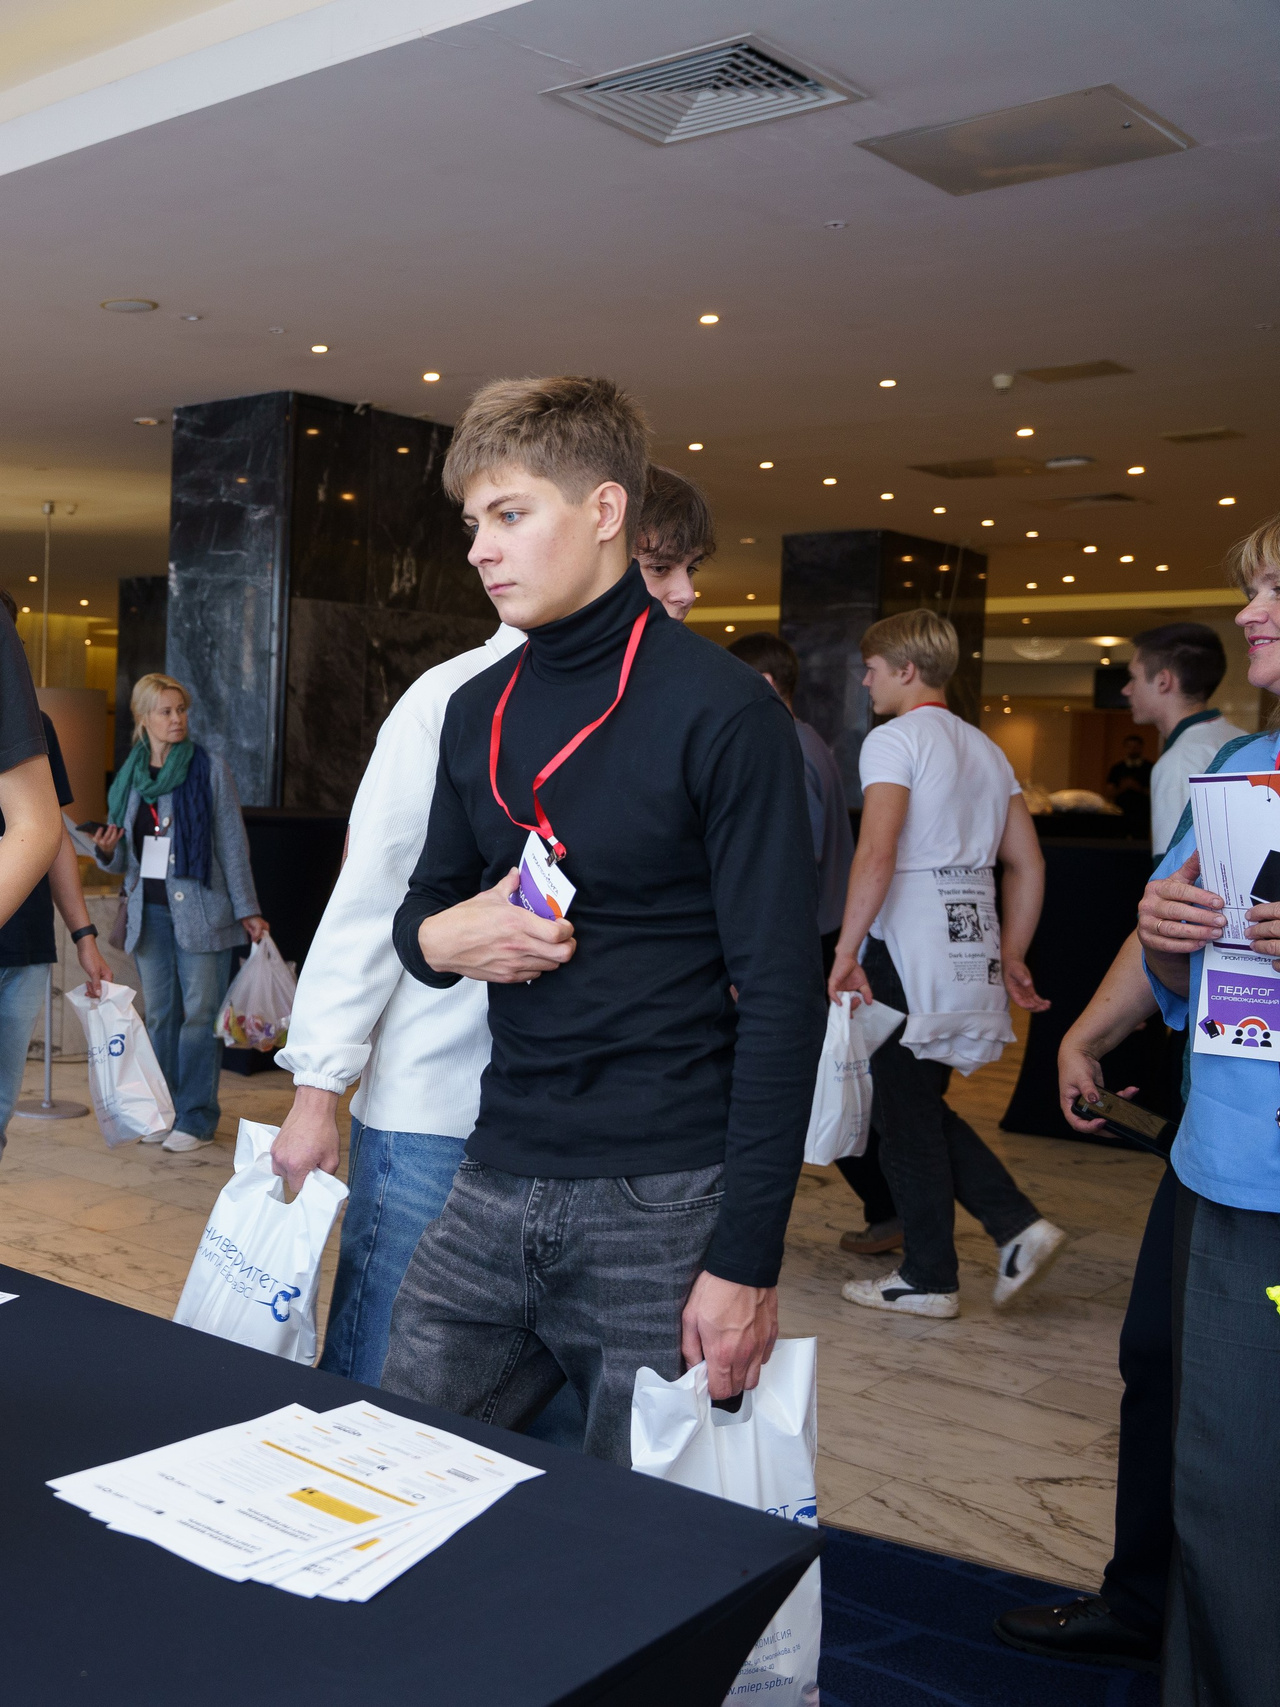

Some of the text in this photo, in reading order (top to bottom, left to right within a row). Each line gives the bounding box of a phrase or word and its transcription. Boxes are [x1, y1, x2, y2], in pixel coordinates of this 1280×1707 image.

[1221, 955, 1272, 963] ПРОМТЕХНОЛИ
[1217, 985, 1275, 996] ПЕДАГОГ
[1211, 995, 1280, 1005] СОПРОВОЖДАЮЩИЙ
[727, 1676, 794, 1696] w.miep.spb.ru
